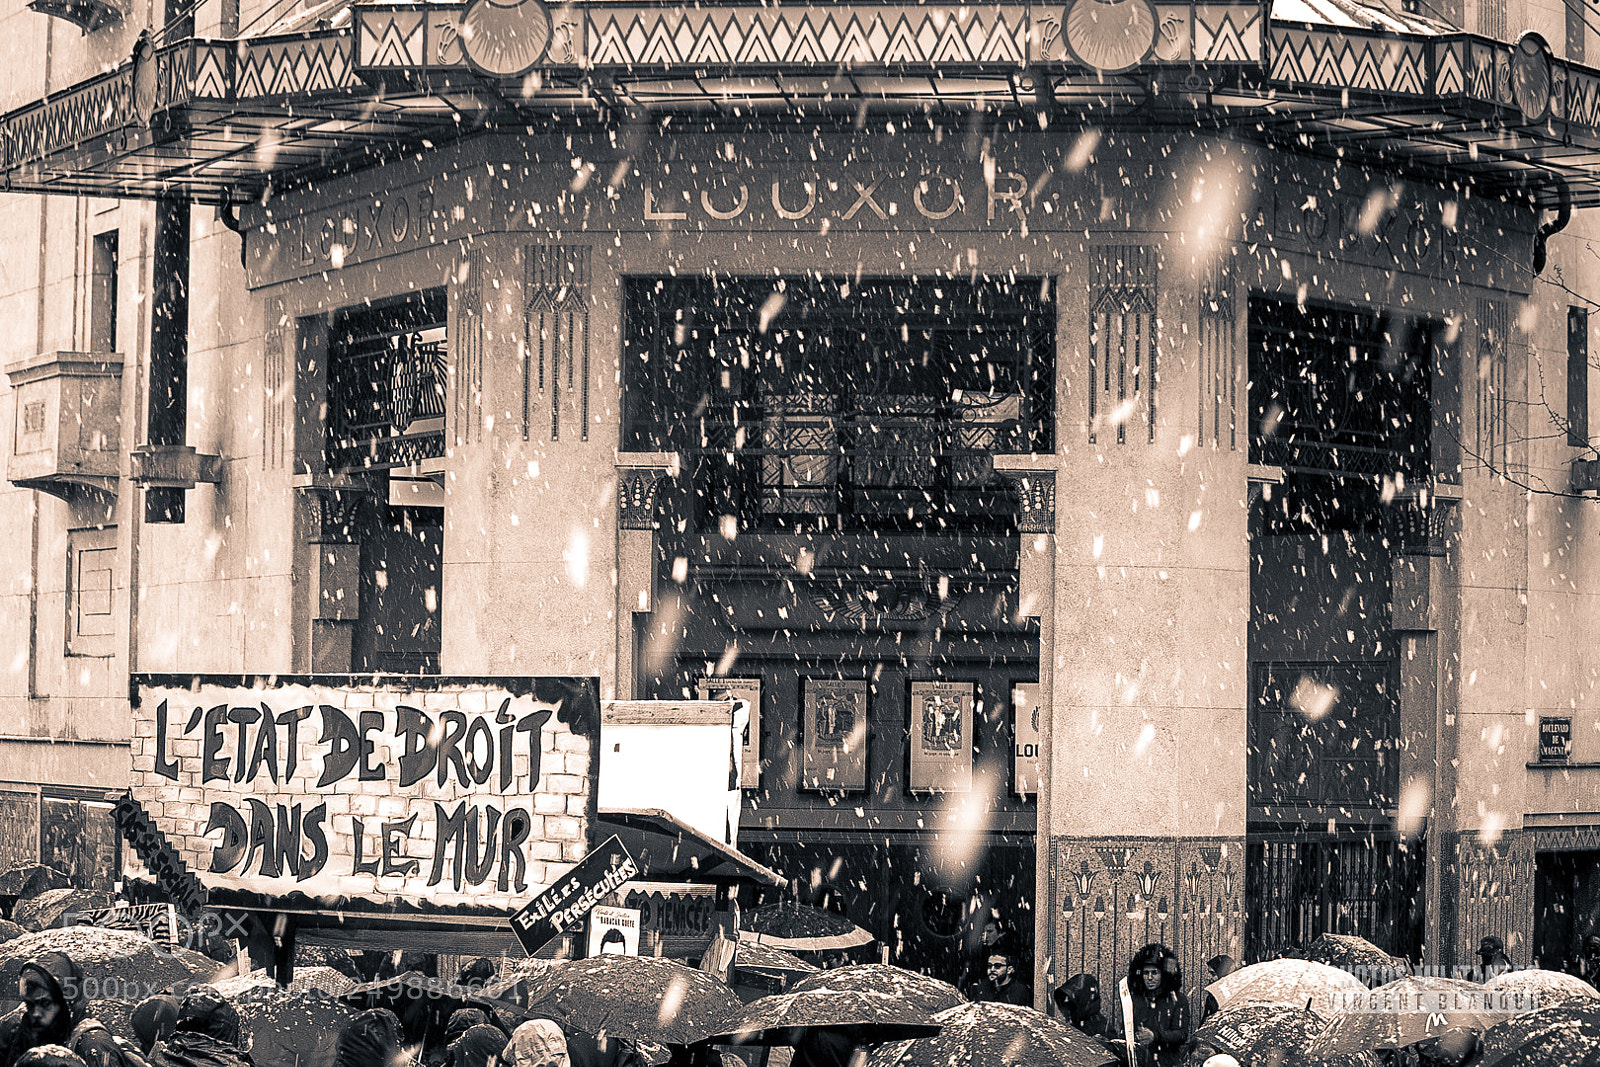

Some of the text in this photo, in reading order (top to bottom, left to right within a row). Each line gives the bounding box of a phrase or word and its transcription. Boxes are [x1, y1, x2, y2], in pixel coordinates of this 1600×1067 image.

[301, 190, 434, 268] LOUXOR
[643, 171, 1028, 221] LOUXOR
[1273, 190, 1458, 271] LOUXOR
[154, 698, 314, 785] L'ETAT
[316, 703, 386, 788] DE
[1542, 724, 1569, 733] BOULEVARD
[1552, 735, 1559, 744] DE
[202, 798, 531, 893] DANS LE MUR
